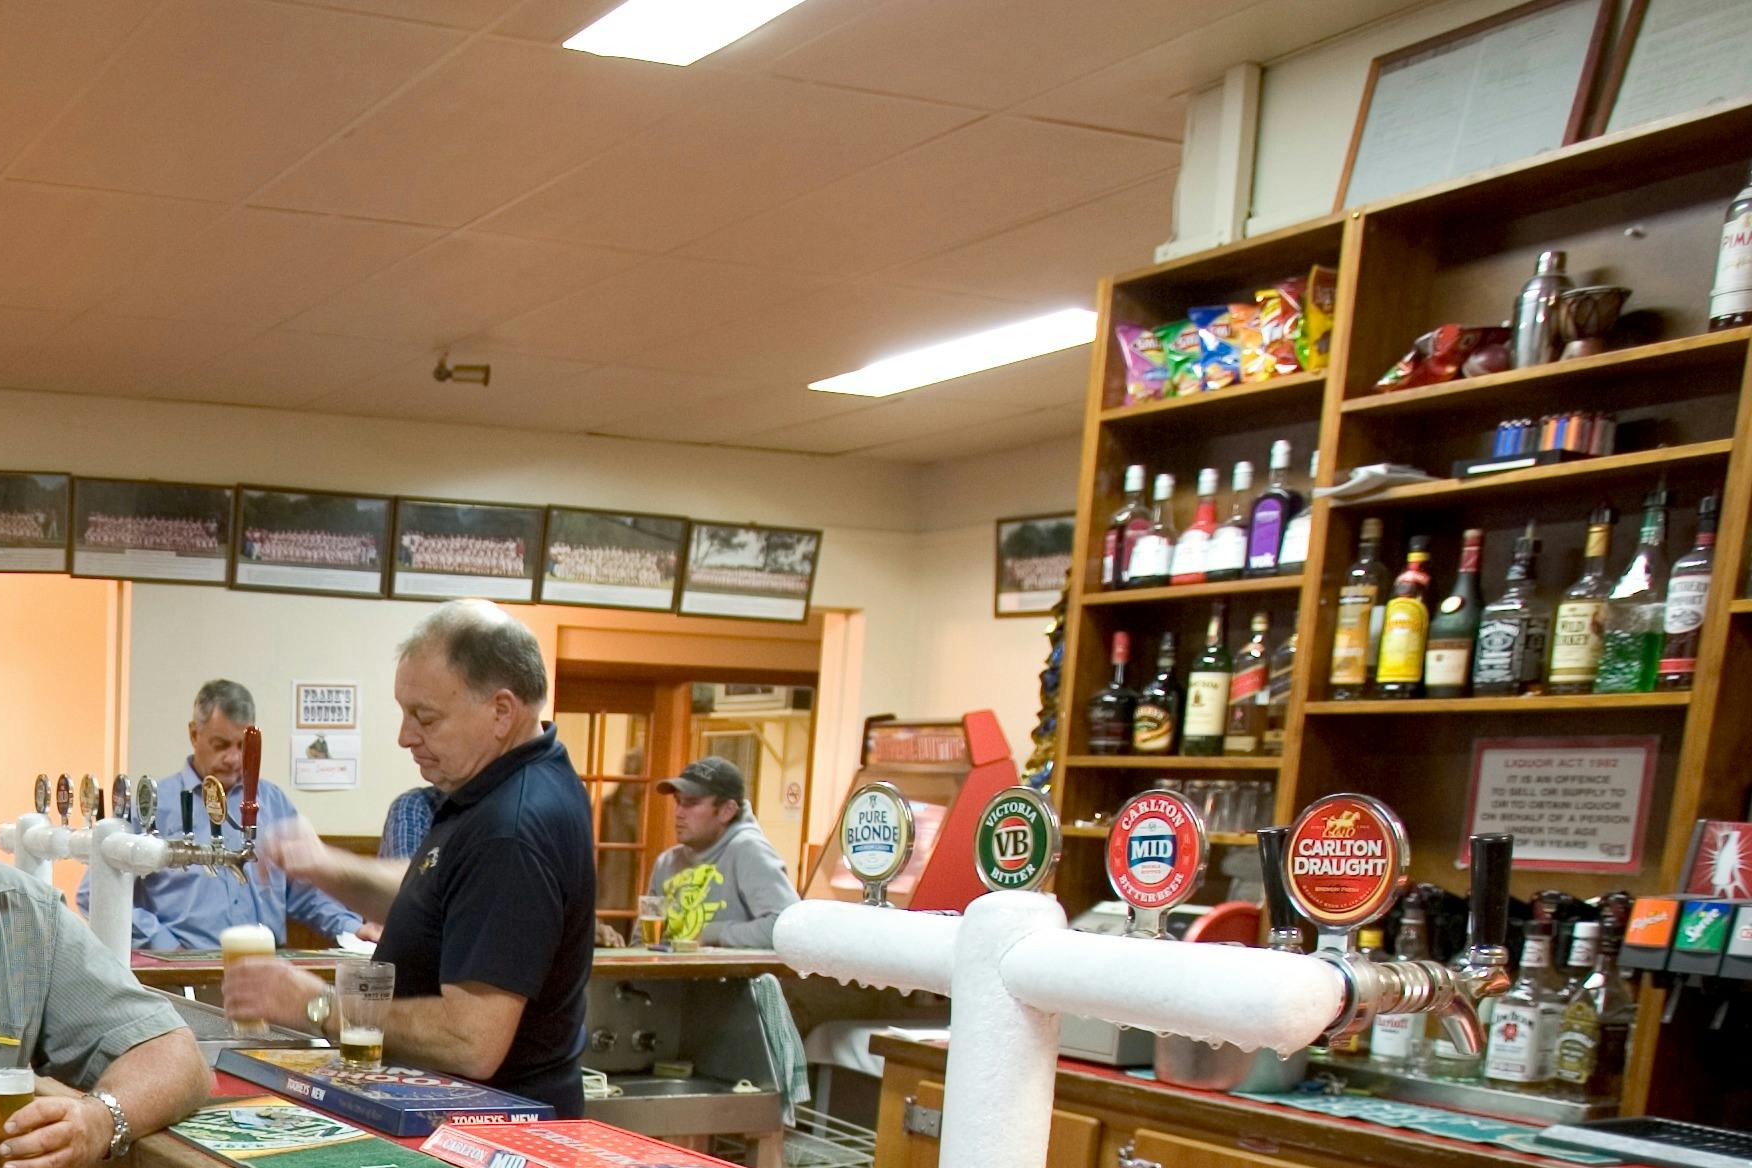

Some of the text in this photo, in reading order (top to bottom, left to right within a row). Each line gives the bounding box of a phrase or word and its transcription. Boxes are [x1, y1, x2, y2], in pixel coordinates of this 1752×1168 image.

[1504, 758, 1553, 768] LIQUOR
[1558, 758, 1583, 768] ACT
[1555, 775, 1611, 785] OFFENCE
[1509, 787, 1538, 797] SELL
[1561, 787, 1606, 798] SUPPLY
[1574, 801, 1622, 811] LIQUOR
[858, 811, 887, 825] PURE
[986, 802, 1037, 828] VICTORIA
[1121, 800, 1185, 830] CARLTON
[1499, 813, 1545, 822] BEHALF
[1579, 814, 1630, 824] PERSON
[848, 826, 898, 844] BLONDE
[1504, 826, 1597, 837] UNDER THE AGE
[995, 829, 1029, 857] VB
[1131, 840, 1173, 860] MID
[1299, 839, 1382, 856] CARLTON
[990, 864, 1036, 884] BITTER
[1294, 857, 1387, 876] DRAUGHT
